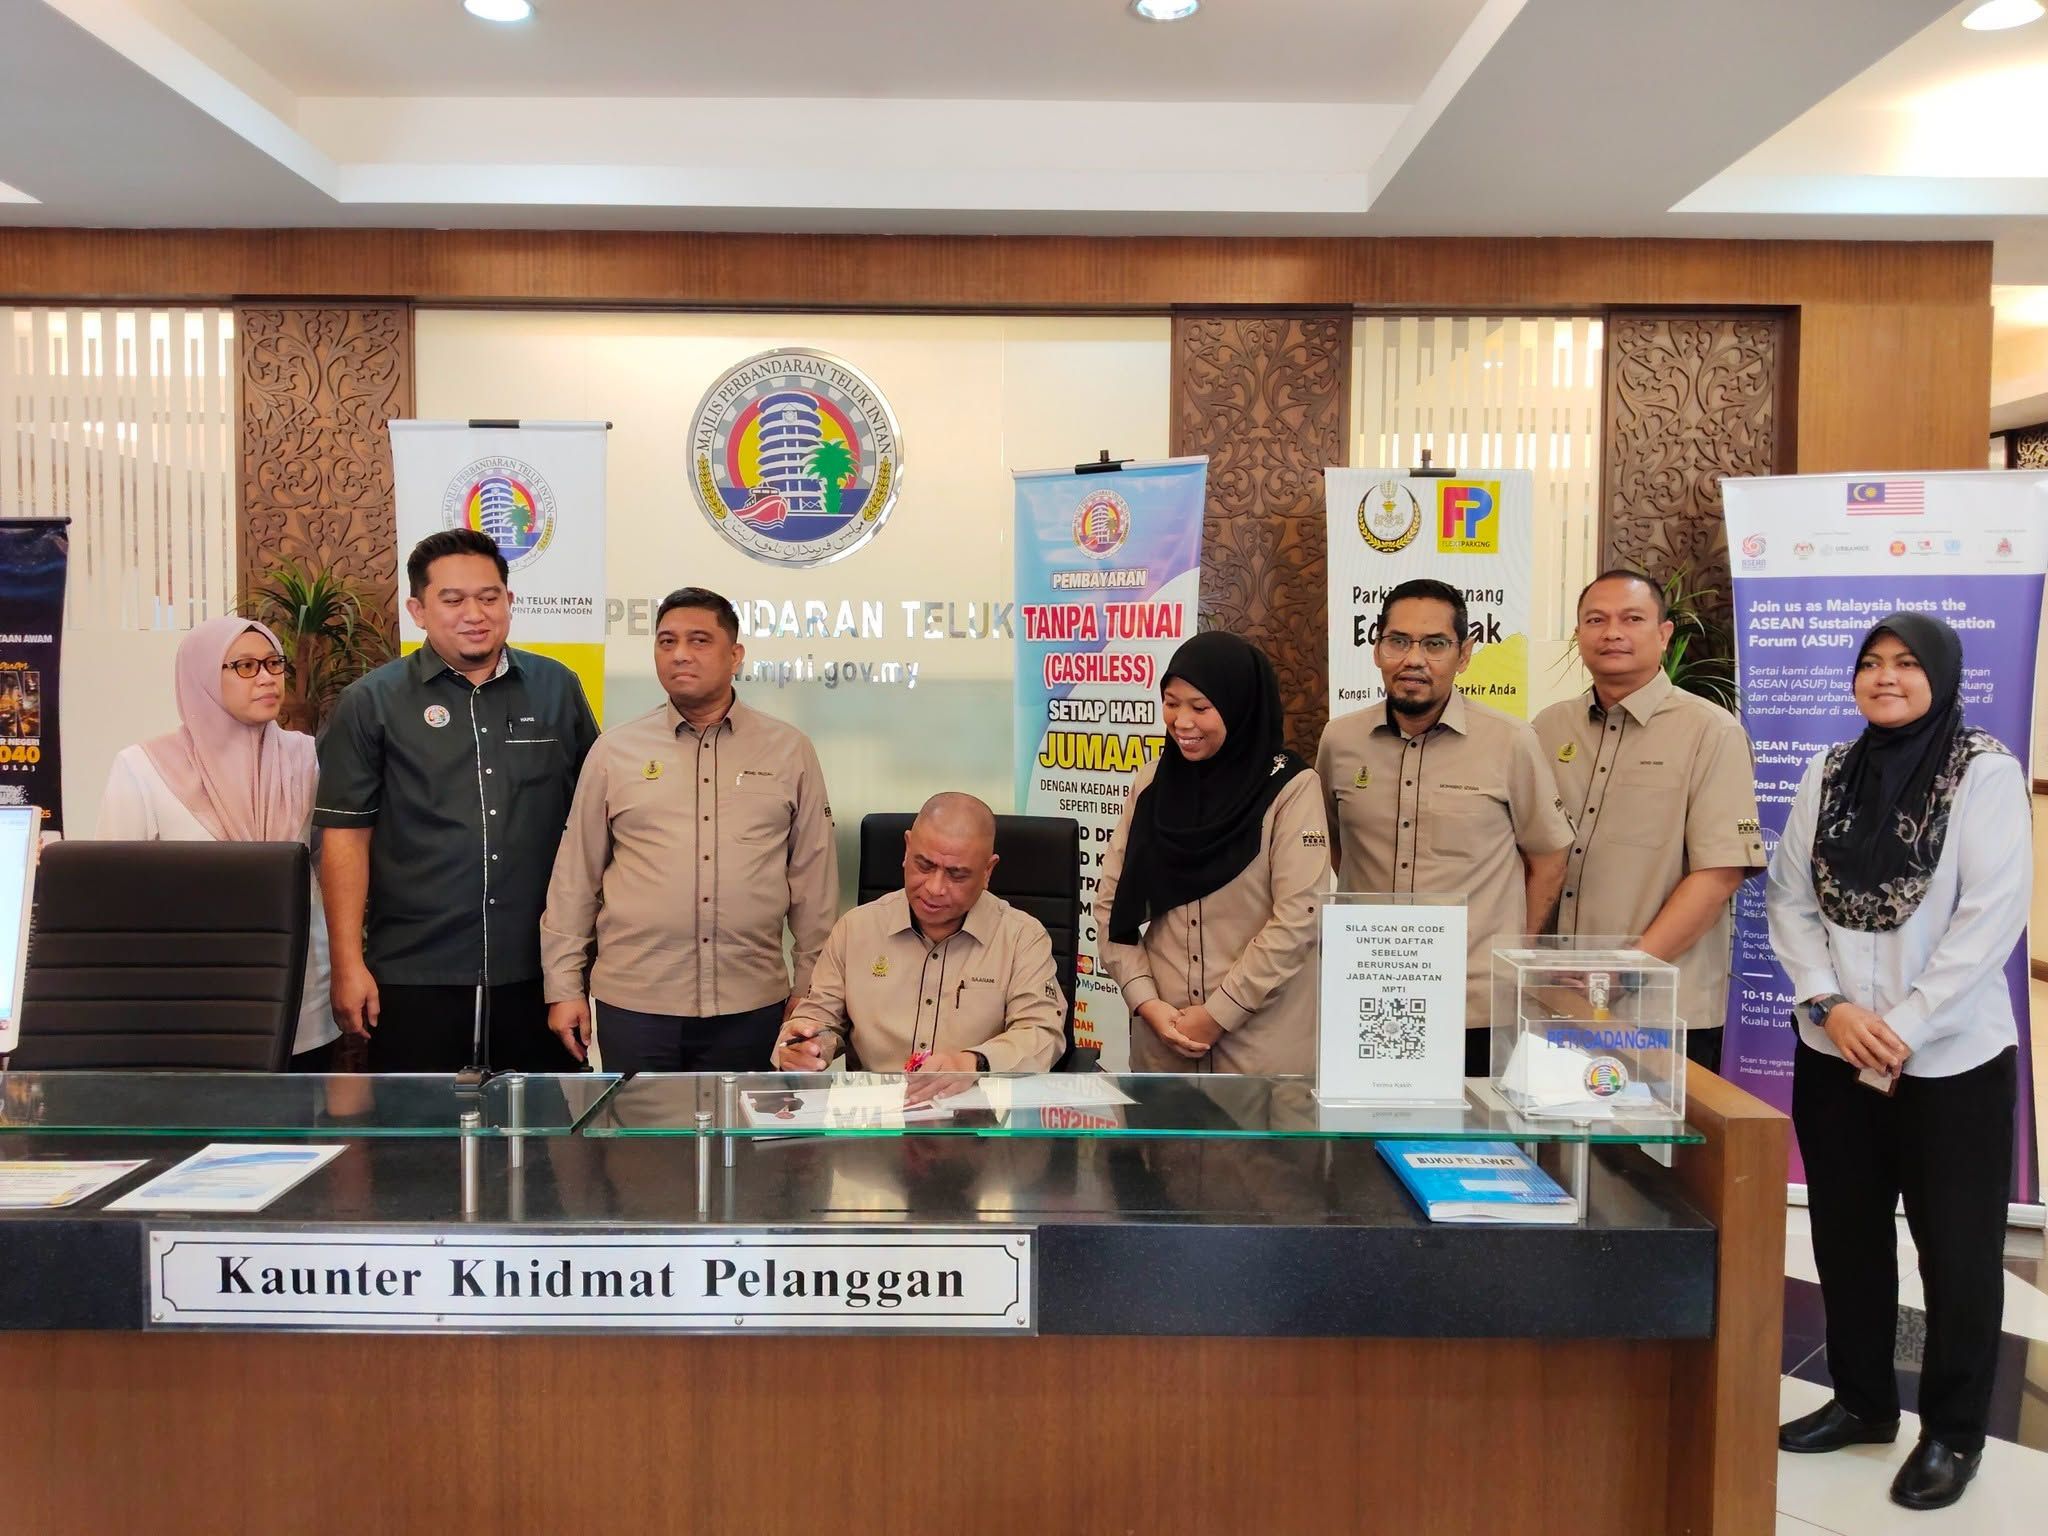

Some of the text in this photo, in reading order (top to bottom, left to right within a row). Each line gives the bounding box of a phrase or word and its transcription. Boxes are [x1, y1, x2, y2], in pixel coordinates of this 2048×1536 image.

[697, 359, 892, 454] MAJLIS PERBANDARAN TELUK INTAN
[1053, 570, 1147, 589] PEMBAYARAN
[526, 596, 558, 605] TELUK
[560, 597, 593, 606] INTAN
[1352, 586, 1393, 604] Parki
[512, 607, 542, 615] PINTAR
[544, 607, 561, 615] DAN
[1749, 598, 1966, 614] Join us as Malaysia hosts the
[604, 598, 1015, 639] PENDARAN TELUK
[1022, 602, 1183, 641] TANPA TUNAI
[1749, 616, 1995, 630] ASEAN Sustainab isation
[24, 634, 52, 643] AWAM
[1749, 634, 1854, 648] Forum (ASUF)
[735, 654, 920, 688] .mpti.gov.my
[1044, 653, 1155, 690] (CASHLESS)
[1749, 666, 1780, 676] Sertai
[1782, 666, 1808, 676] kami
[1810, 666, 1843, 676] dalam
[1748, 679, 1788, 689] ASEAN
[1790, 679, 1828, 690] (ASUF)
[1830, 679, 1852, 691] bag
[1339, 688, 1371, 700] Kongsi
[1489, 684, 1516, 695] Anda
[1748, 692, 1768, 702] dan
[1771, 692, 1815, 702] cabaran
[1817, 692, 1856, 702] urbanis
[1983, 694, 1994, 704] di
[1048, 699, 1154, 724] SETIAP HARI
[1748, 705, 1826, 715] bandar-bandar
[1829, 705, 1840, 715] di
[1039, 731, 1166, 772] JUMAAT
[1792, 741, 1829, 751] Future
[0, 746, 40, 763] 040
[1040, 779, 1078, 793] DENGAN
[1080, 782, 1119, 797] KAEDAH
[1779, 781, 1800, 792] Dep
[1060, 799, 1123, 815] SEPERTI BERI
[1401, 925, 1415, 933] QR
[1371, 949, 1418, 957] SEBELUM
[1357, 961, 1418, 969] BERURUSAN
[1346, 973, 1442, 982] JABATAN-JABATAN
[1082, 979, 1118, 994] MyDebit
[1742, 990, 1773, 1001] 10-15
[1741, 1003, 1770, 1014] Kuala
[1074, 1019, 1094, 1032] DAH
[1741, 1016, 1770, 1027] Kuala
[1740, 1056, 1794, 1068] Scan to registe
[1764, 1068, 1784, 1077] untuk
[1417, 1157, 1515, 1166] BUKU PELAWAT
[216, 1254, 965, 1308] Kaunter Khidmat Pelanggan
